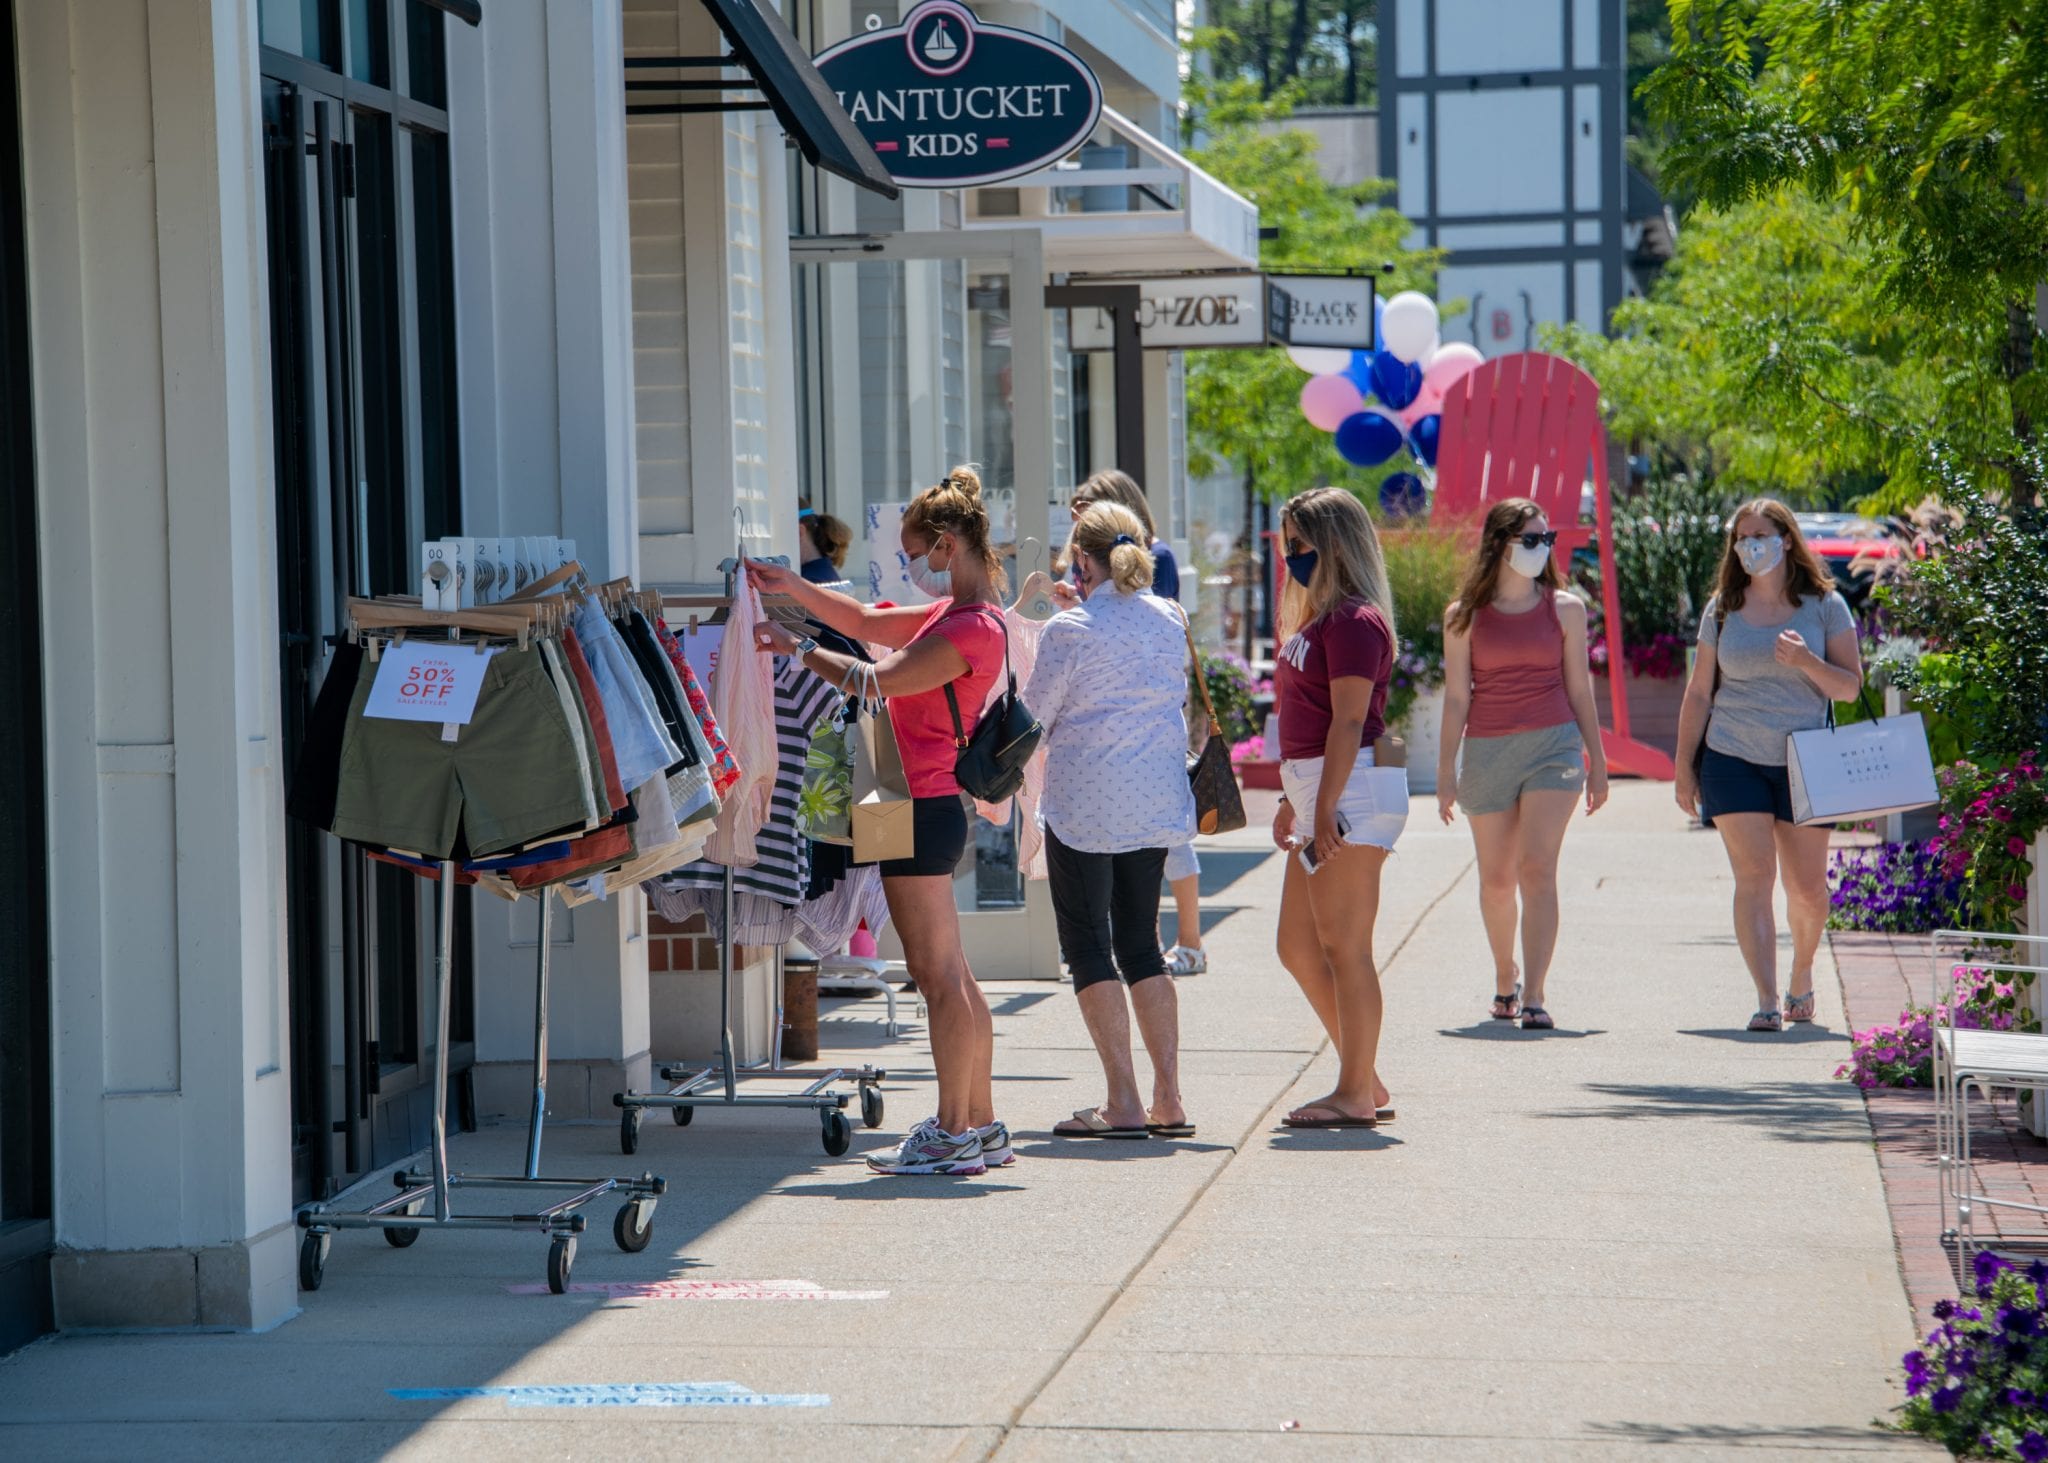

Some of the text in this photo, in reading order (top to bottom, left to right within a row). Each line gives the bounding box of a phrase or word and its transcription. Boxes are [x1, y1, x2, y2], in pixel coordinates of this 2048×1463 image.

[906, 133, 978, 157] KIDS
[1290, 299, 1357, 318] BLACK
[428, 548, 443, 559] 00
[479, 544, 486, 555] 2
[408, 666, 455, 682] 50%
[400, 682, 453, 698] OFF
[1840, 745, 1884, 758] WHITE
[1847, 763, 1890, 775] BLACK
